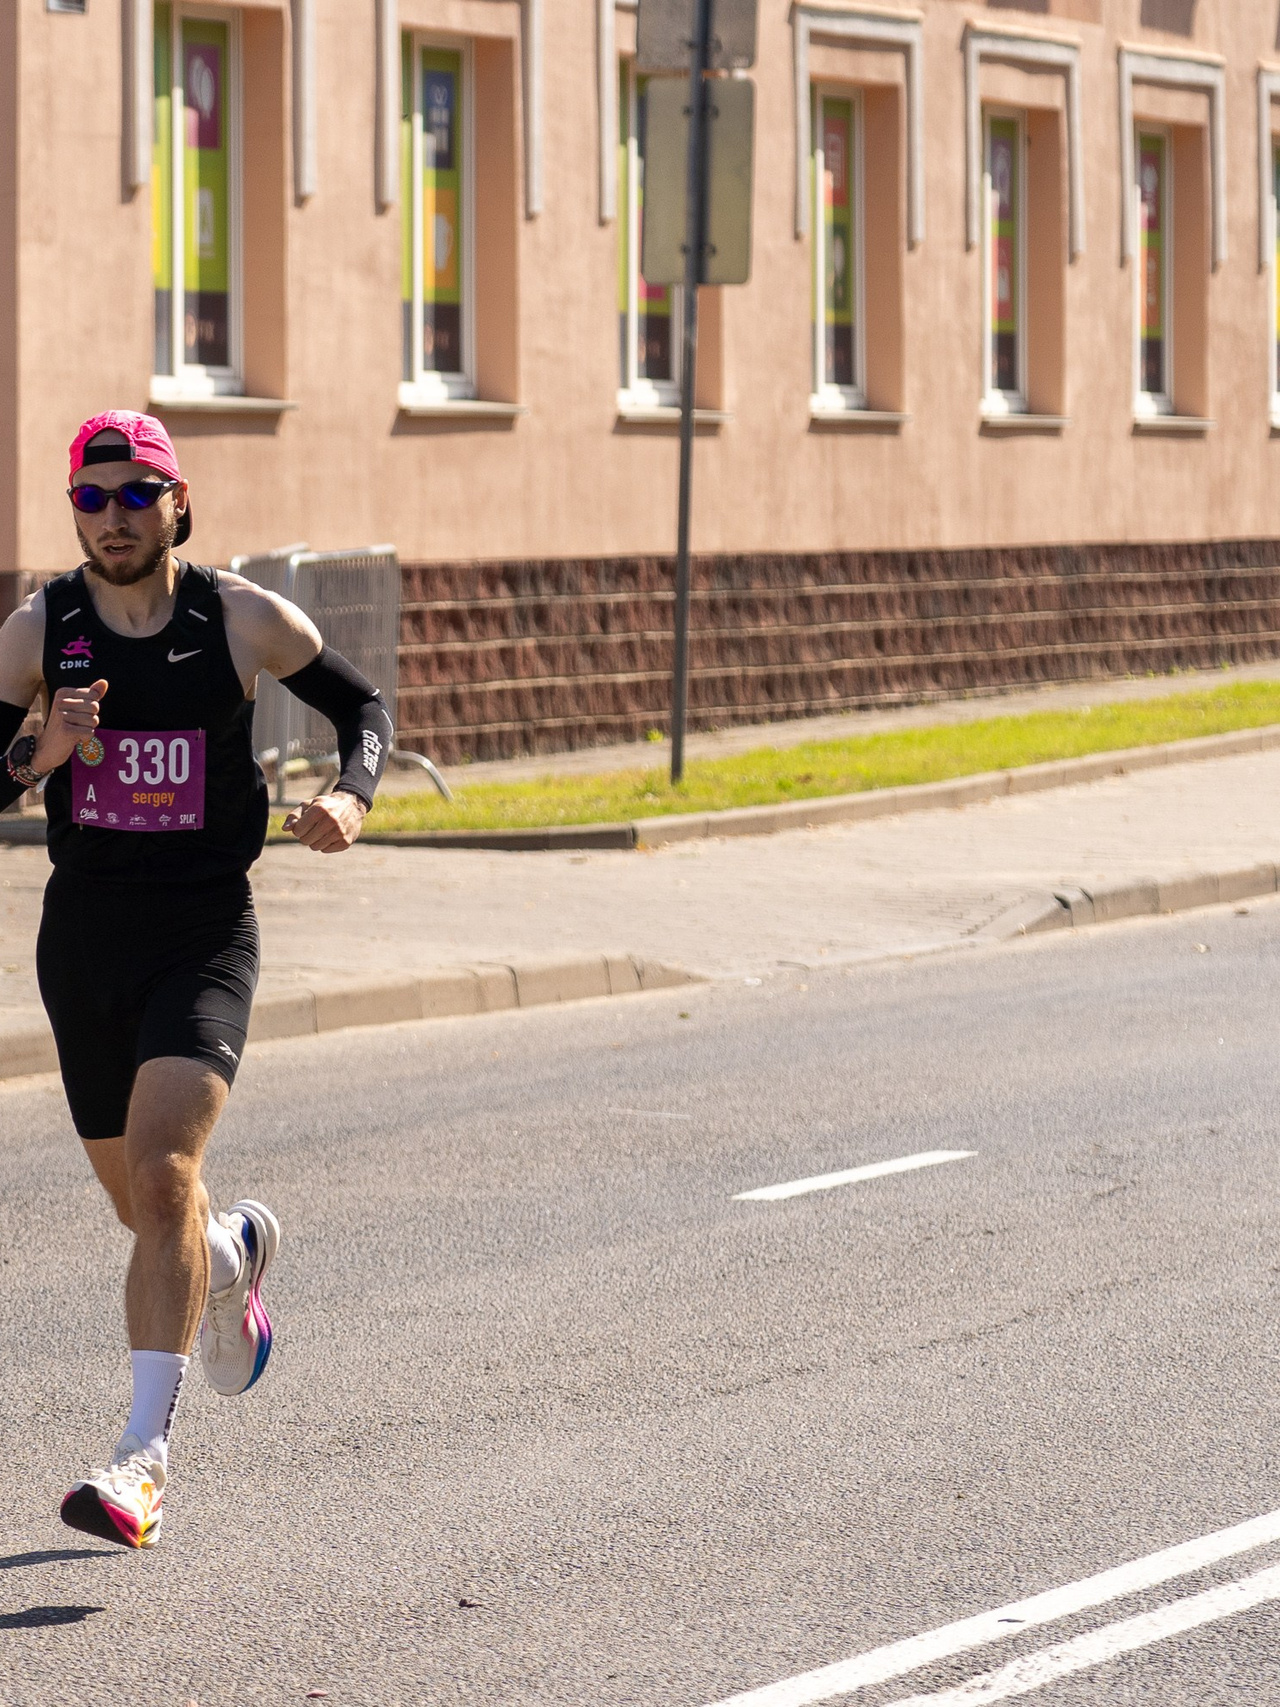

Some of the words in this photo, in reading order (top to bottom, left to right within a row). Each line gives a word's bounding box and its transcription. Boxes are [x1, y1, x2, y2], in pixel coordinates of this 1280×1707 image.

[60, 660, 90, 670] CDNC
[118, 738, 190, 785] 330
[86, 784, 96, 802] A
[132, 791, 175, 807] sergey
